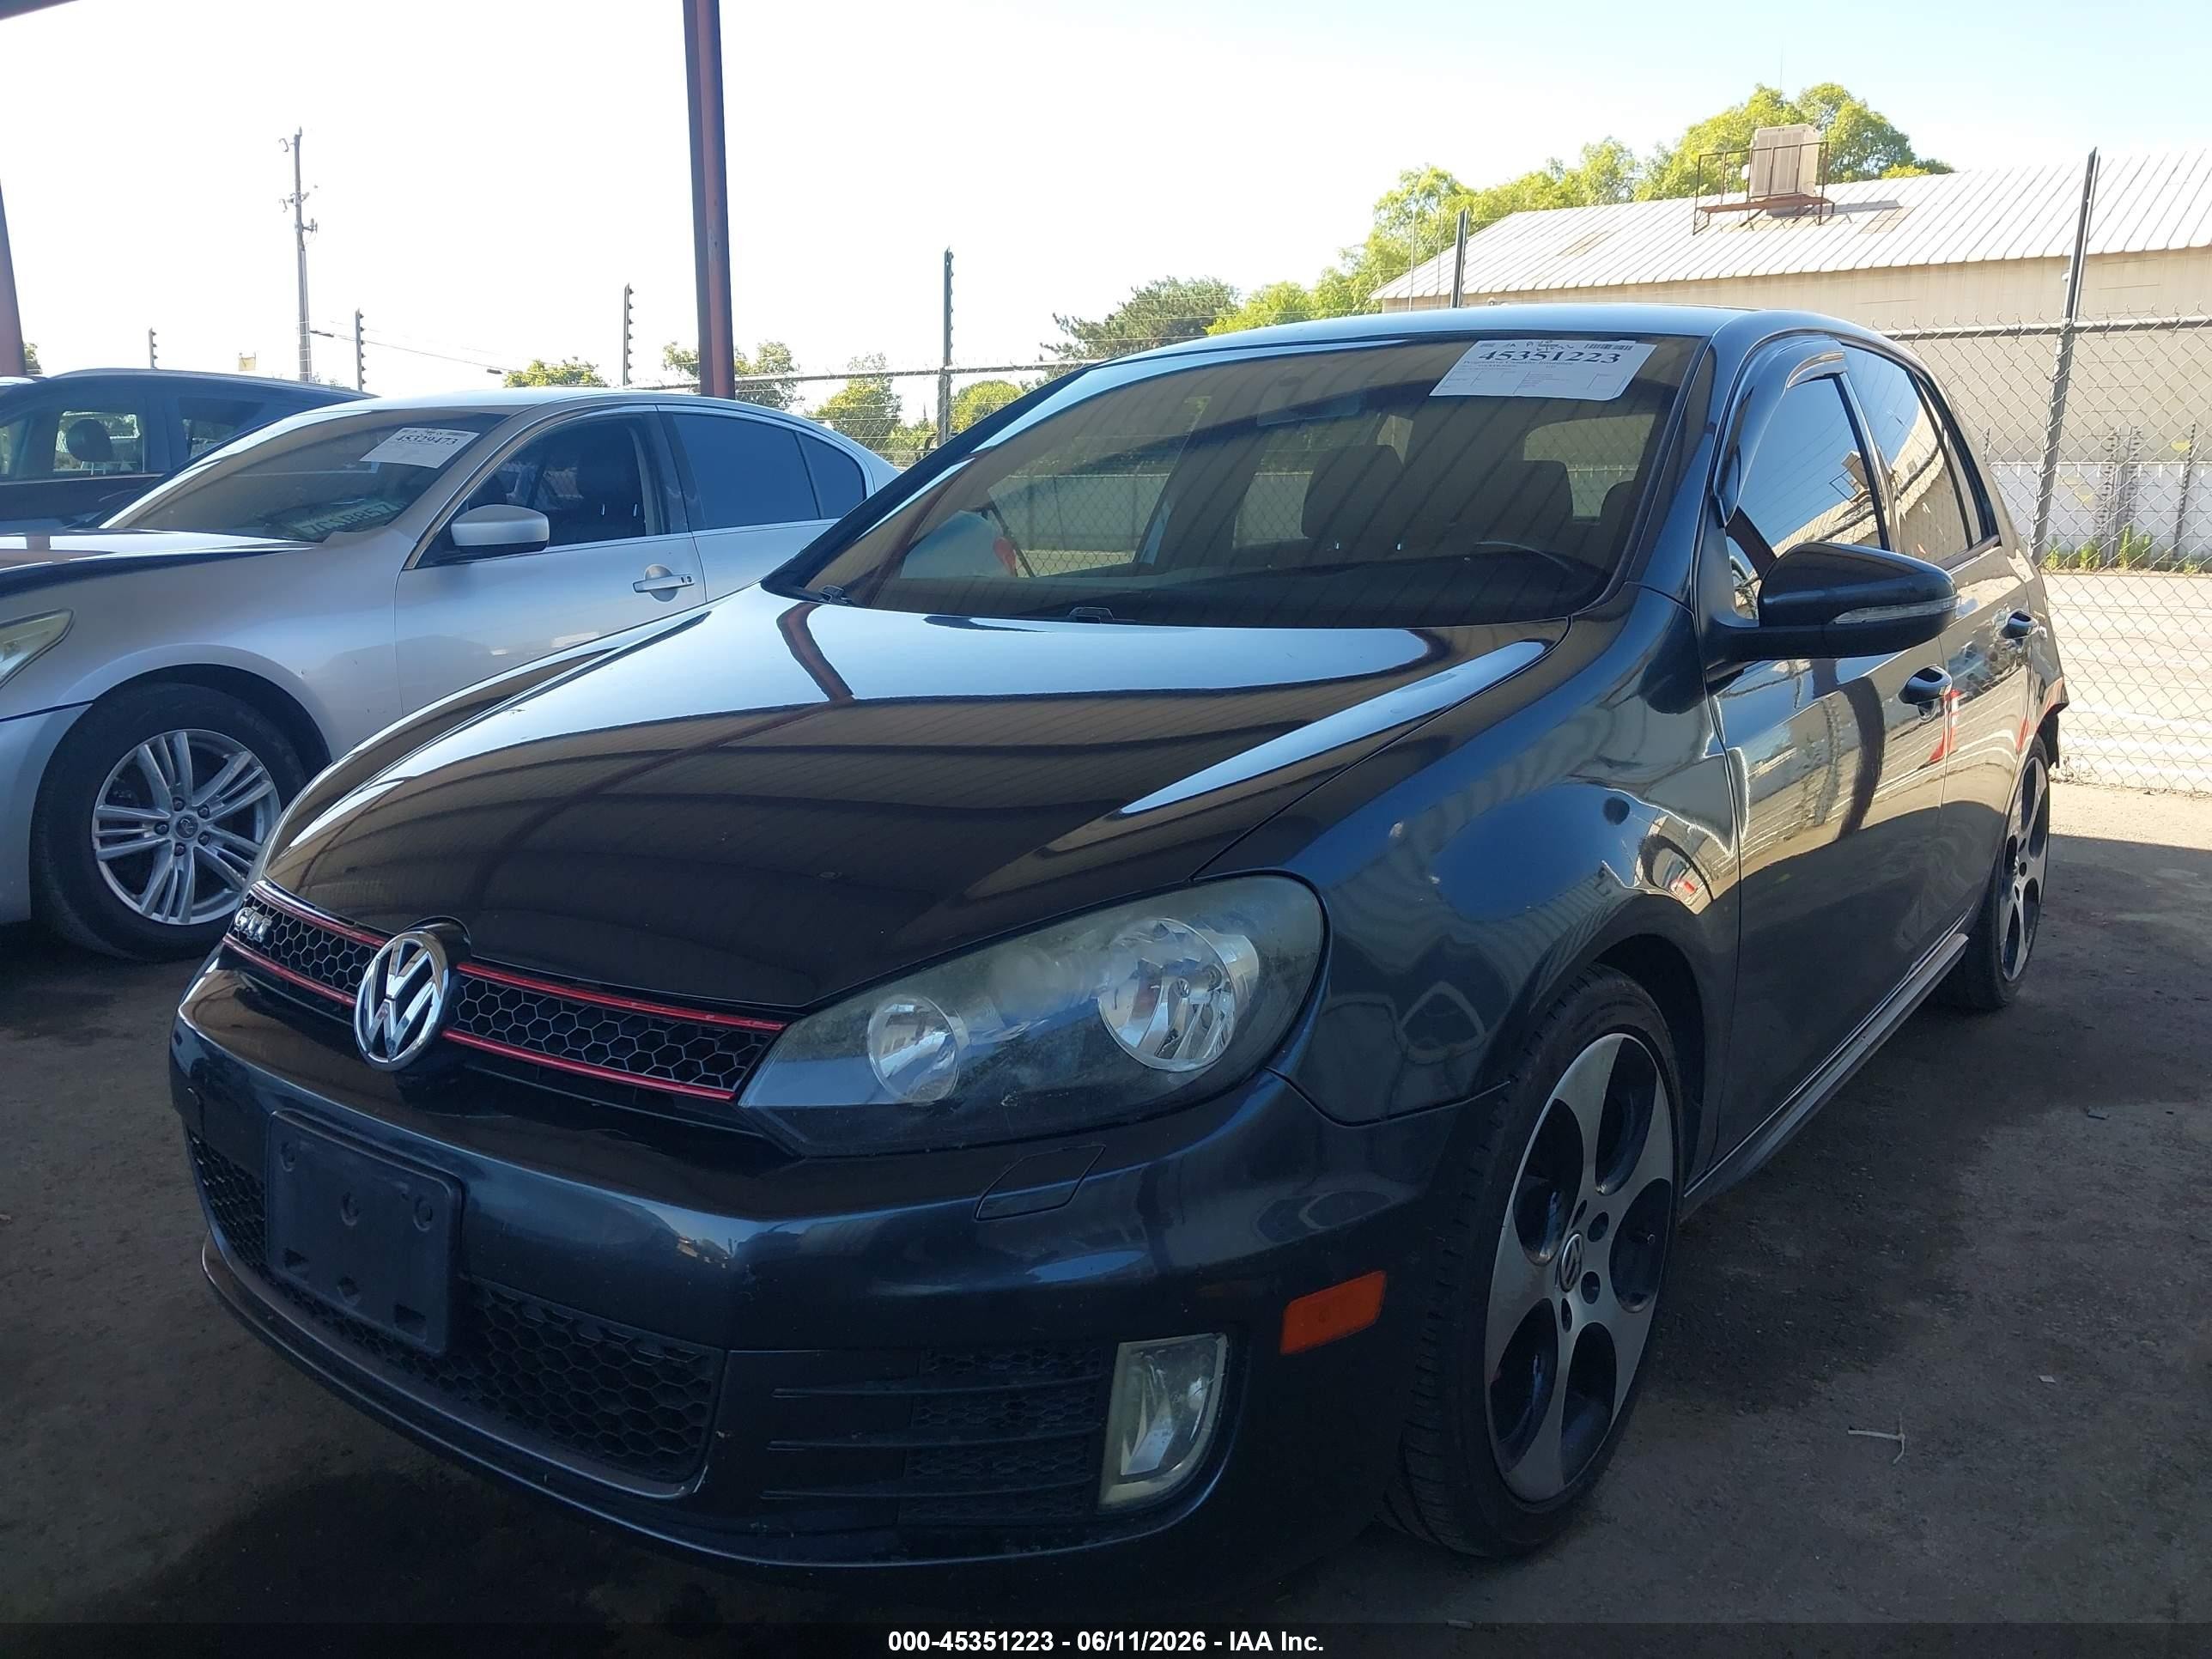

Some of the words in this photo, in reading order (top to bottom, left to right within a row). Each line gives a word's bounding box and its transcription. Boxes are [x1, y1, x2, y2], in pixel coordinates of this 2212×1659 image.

[1478, 349, 1622, 364] 45351223
[234, 907, 273, 944] GTI
[356, 933, 445, 1066] VW
